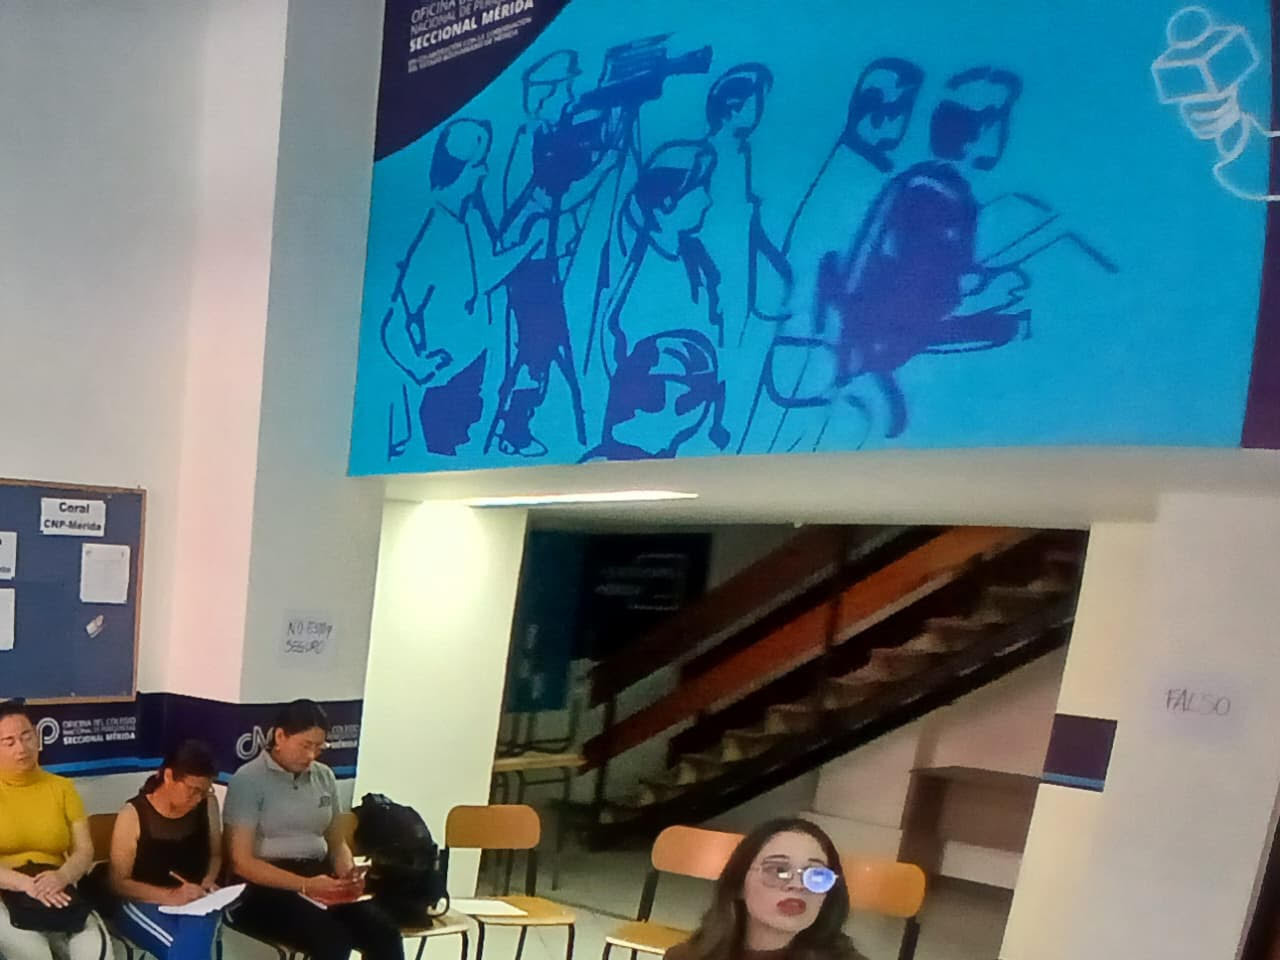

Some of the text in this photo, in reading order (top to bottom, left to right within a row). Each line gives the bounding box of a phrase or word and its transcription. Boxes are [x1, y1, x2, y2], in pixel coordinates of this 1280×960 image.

[409, 16, 478, 52] SECCIONAL
[59, 502, 90, 514] Coral
[1166, 687, 1231, 716] FALSO
